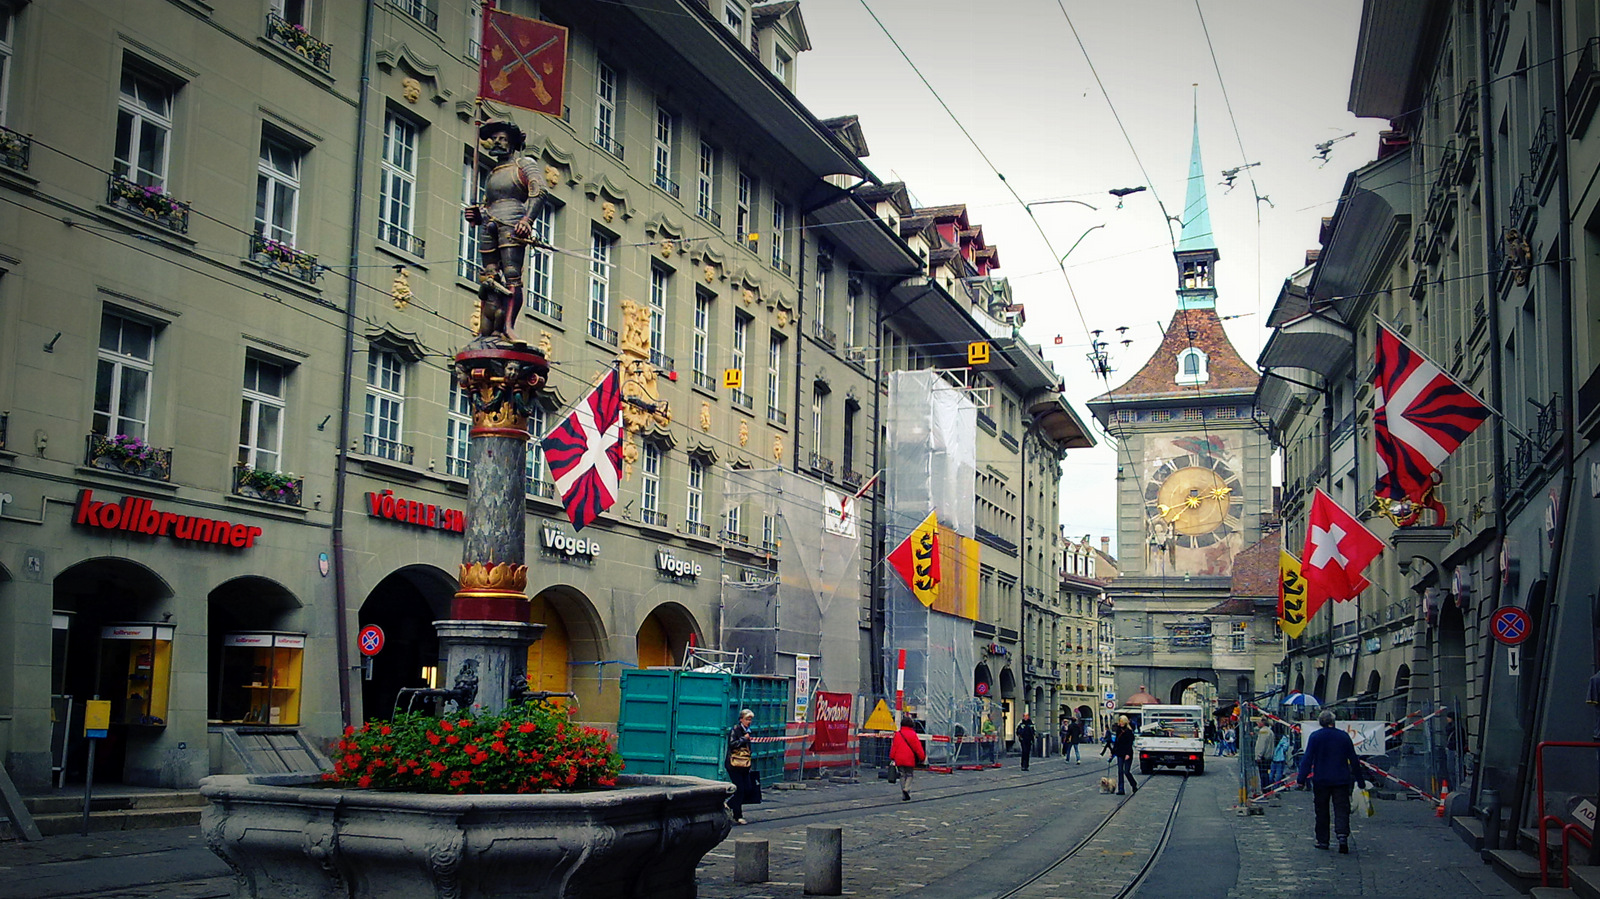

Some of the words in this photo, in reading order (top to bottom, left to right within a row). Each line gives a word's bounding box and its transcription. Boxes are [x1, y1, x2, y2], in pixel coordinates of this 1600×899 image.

[76, 488, 262, 549] kollbrunner
[543, 528, 601, 556] Vögele
[659, 552, 702, 577] Vögele
